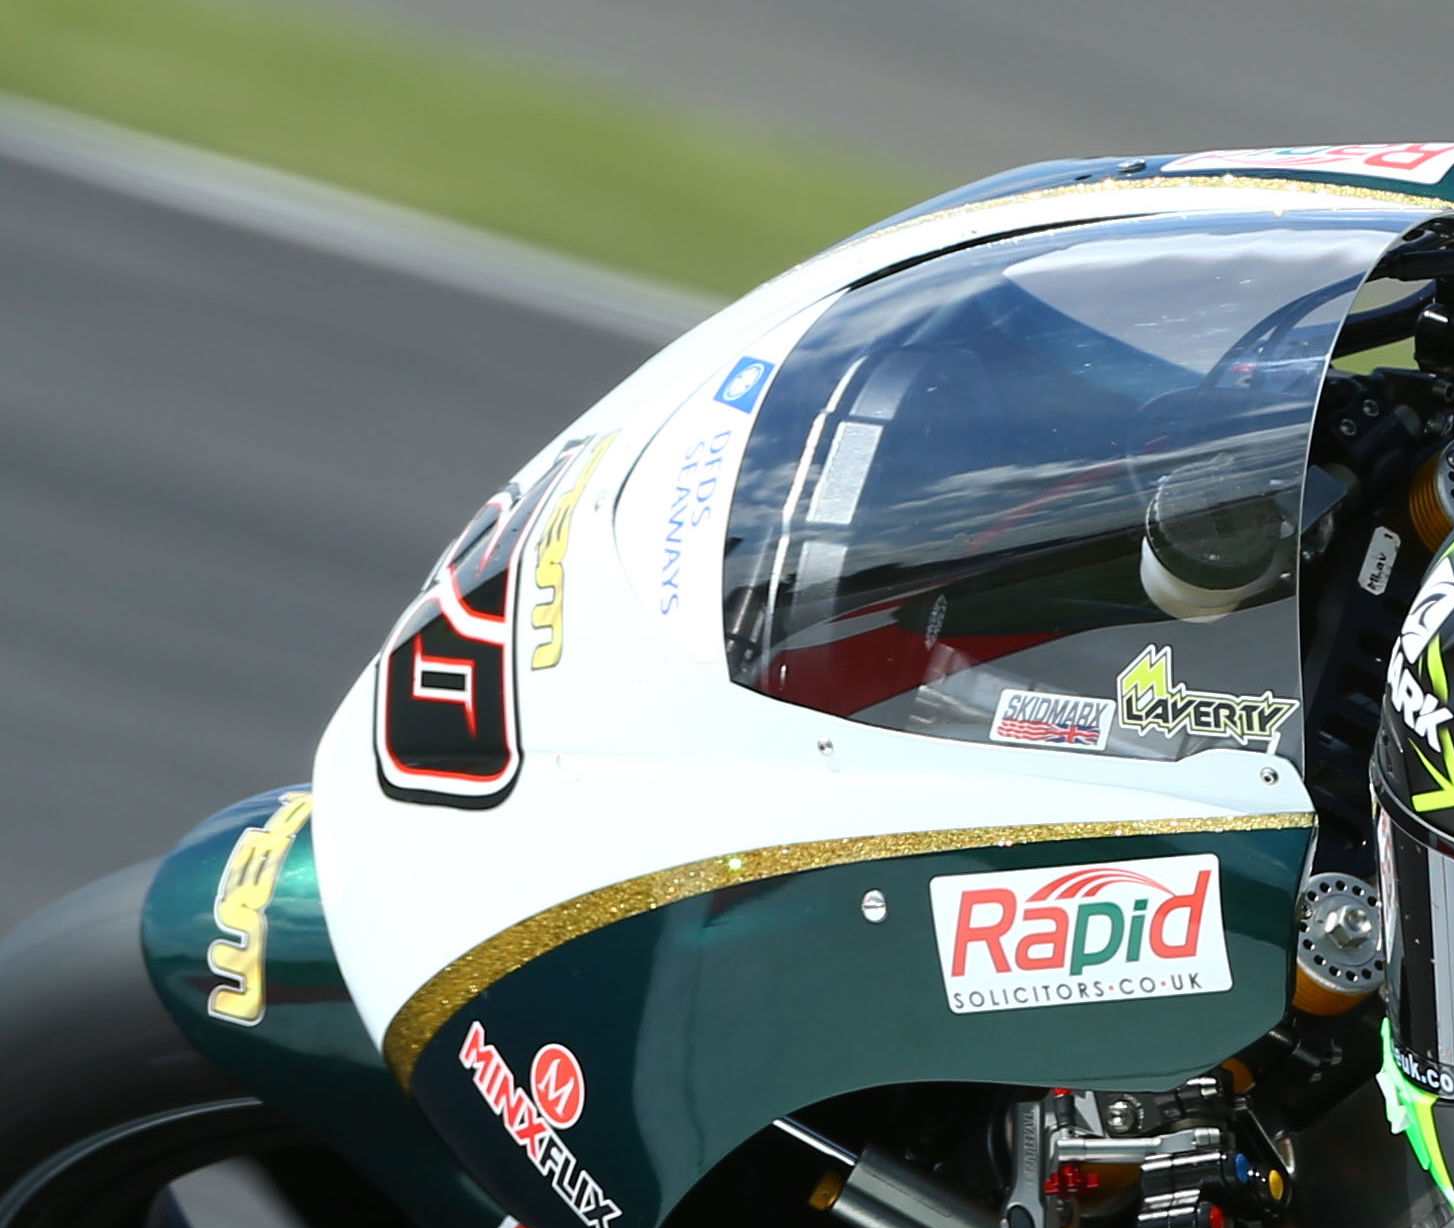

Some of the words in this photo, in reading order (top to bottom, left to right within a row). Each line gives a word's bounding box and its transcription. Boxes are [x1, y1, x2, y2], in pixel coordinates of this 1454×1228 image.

[660, 440, 706, 616] SEAWAYS
[691, 429, 732, 528] DFDS
[950, 868, 1212, 976] Rapid
